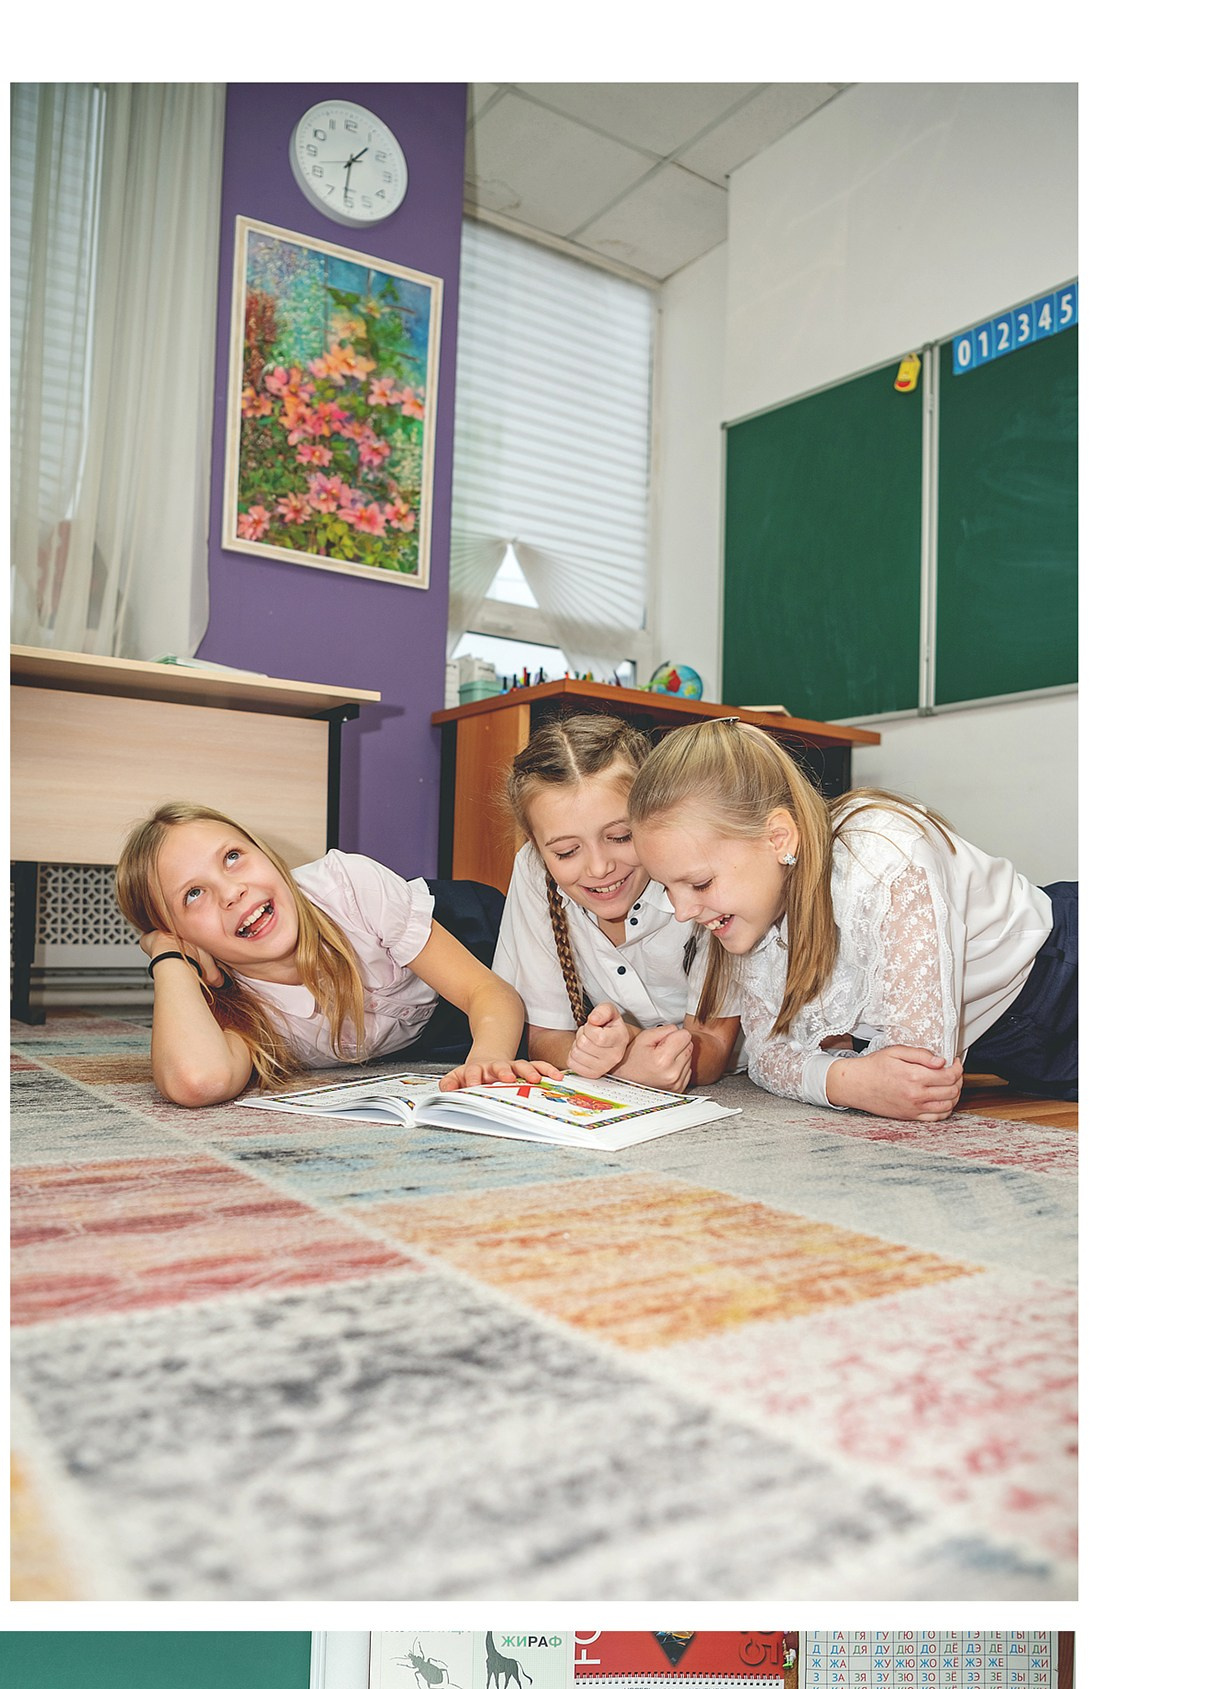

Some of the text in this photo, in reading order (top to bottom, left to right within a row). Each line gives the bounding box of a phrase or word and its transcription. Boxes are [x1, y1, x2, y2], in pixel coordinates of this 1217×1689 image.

[957, 293, 1073, 366] 0 1 2 3 4 5
[501, 1635, 562, 1648] ЖИРАФ
[813, 1644, 890, 1655] Д ДА ДУ
[812, 1659, 891, 1668] Ж ЖА ЖУ
[813, 1672, 889, 1683] З ЗА ЗУ
